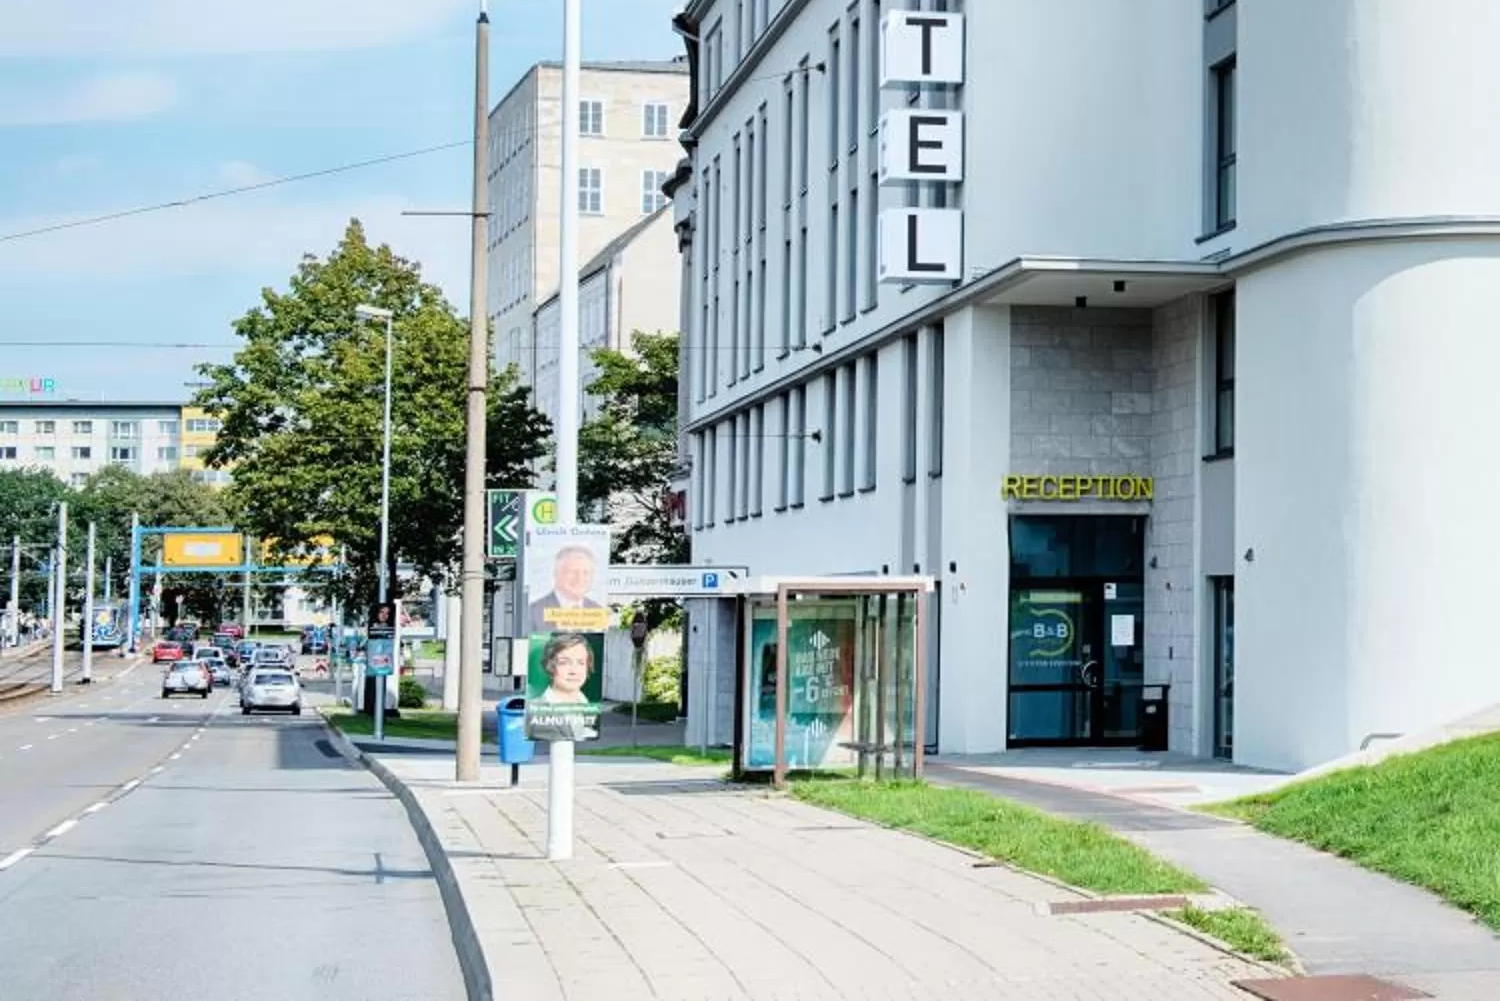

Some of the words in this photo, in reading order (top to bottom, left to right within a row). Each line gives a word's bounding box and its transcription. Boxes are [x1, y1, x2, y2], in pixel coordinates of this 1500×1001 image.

[1002, 474, 1153, 500] RECEPTION
[1033, 623, 1068, 638] B&B
[530, 714, 569, 725] ALMUT
